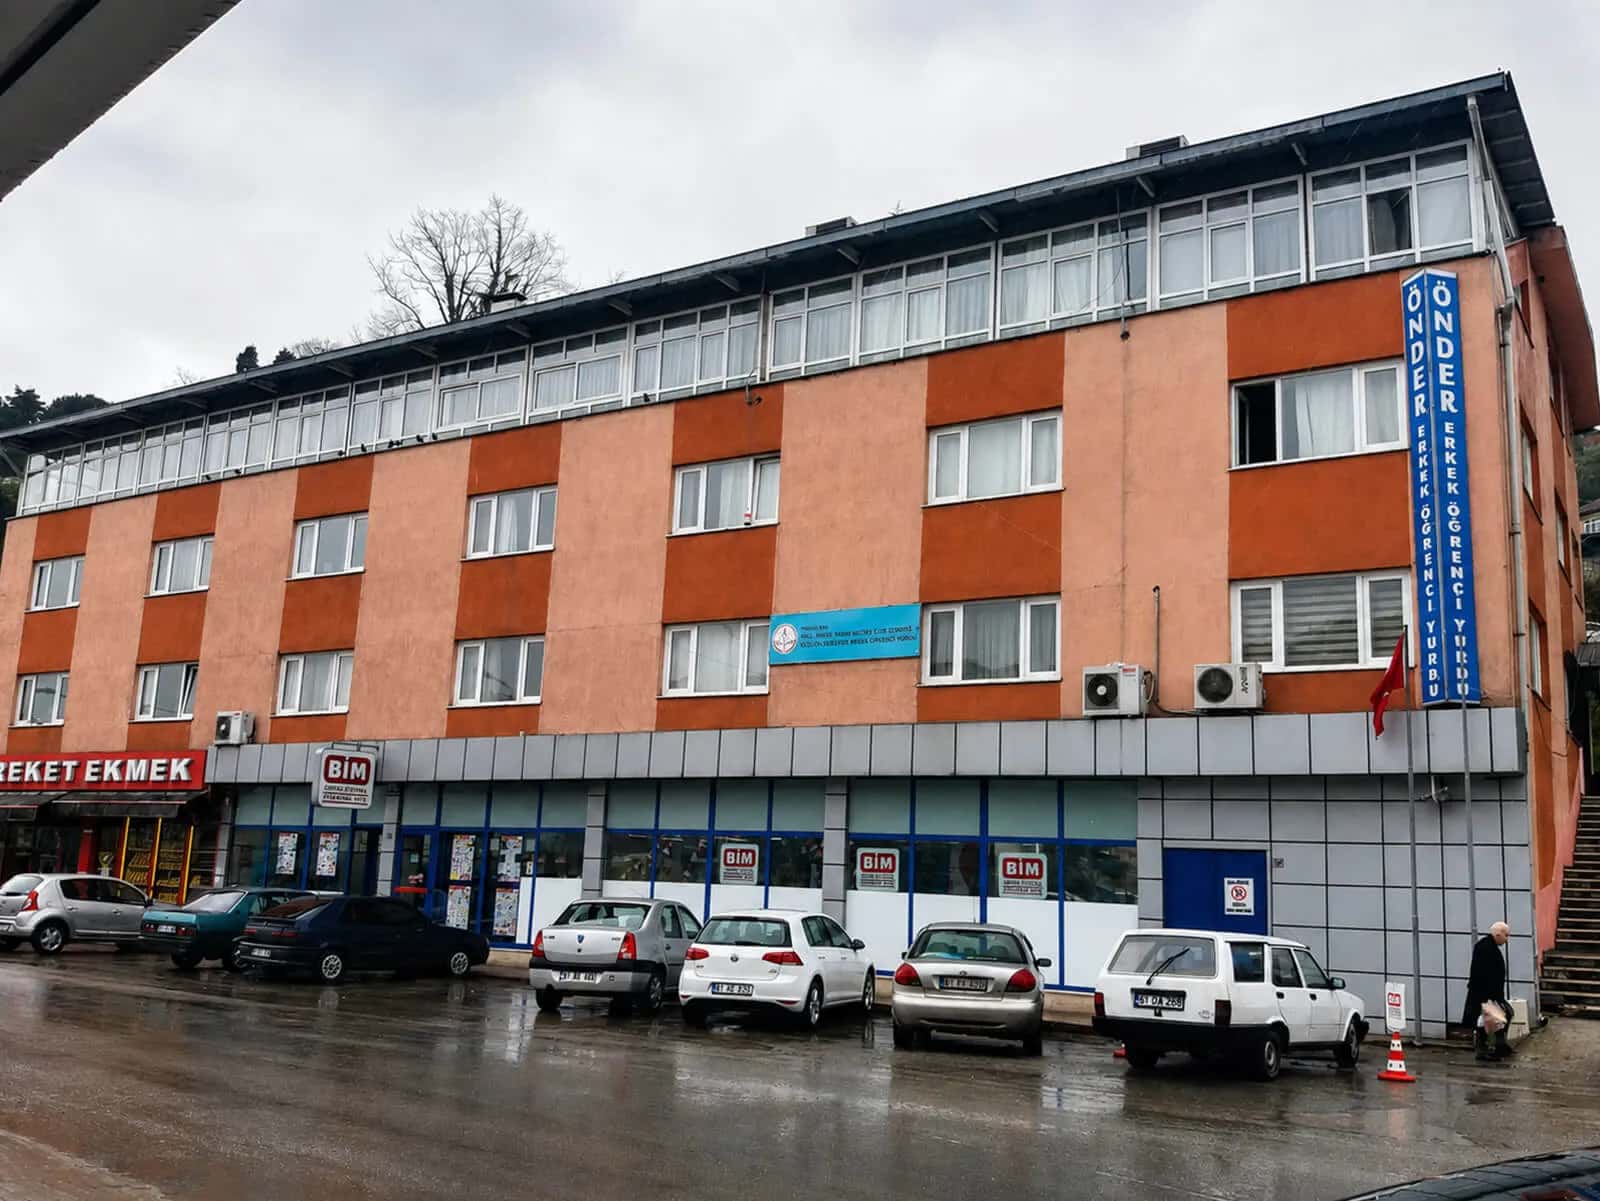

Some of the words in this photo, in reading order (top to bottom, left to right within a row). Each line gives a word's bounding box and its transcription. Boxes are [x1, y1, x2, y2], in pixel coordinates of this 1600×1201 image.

[1432, 280, 1459, 413] ÖNDER
[1407, 284, 1427, 417] ÖNDER
[1417, 425, 1430, 498] ERKEK
[1444, 422, 1459, 495] ERKEK
[1454, 619, 1469, 696] YURDU
[84, 758, 192, 782] EKMEK
